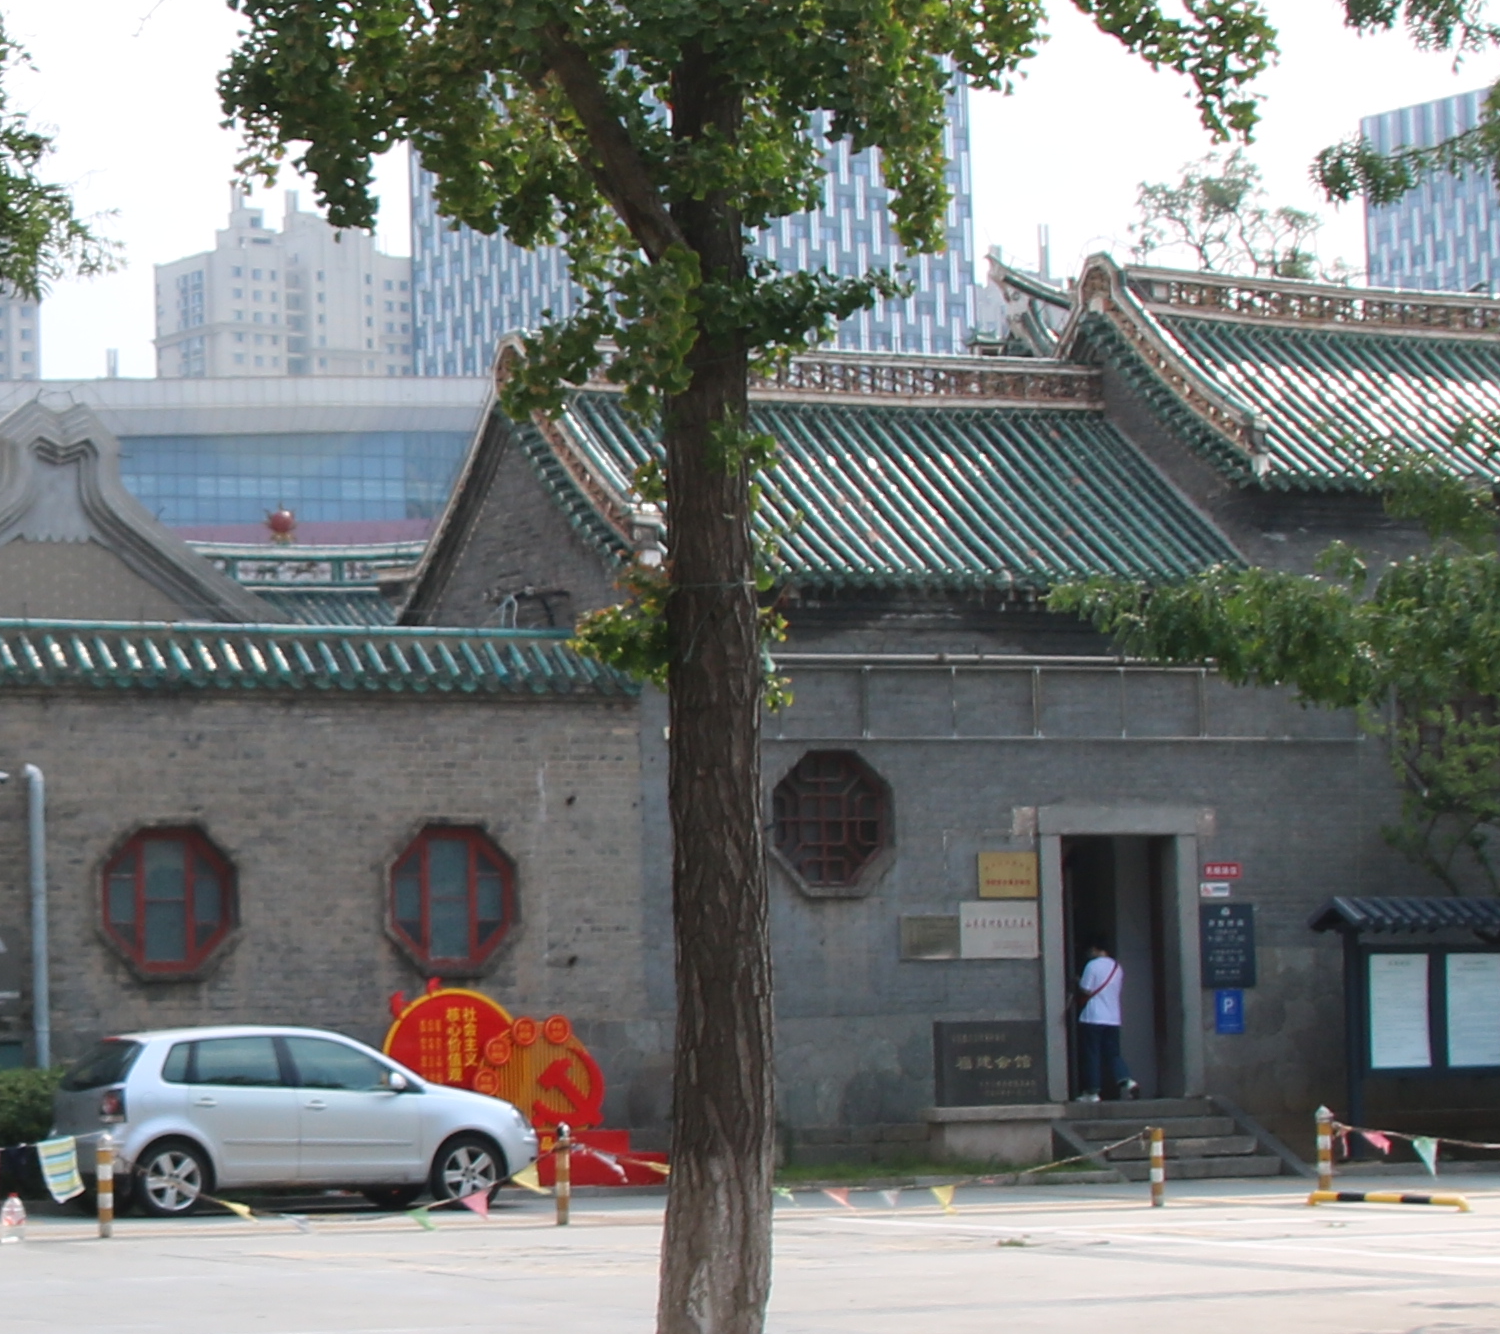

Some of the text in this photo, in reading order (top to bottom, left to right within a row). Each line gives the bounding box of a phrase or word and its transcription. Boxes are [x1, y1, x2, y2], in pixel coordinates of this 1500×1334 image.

[1223, 998, 1235, 1014] P
[446, 1007, 463, 1082] 核心价值观
[463, 1007, 478, 1067] 社会主义
